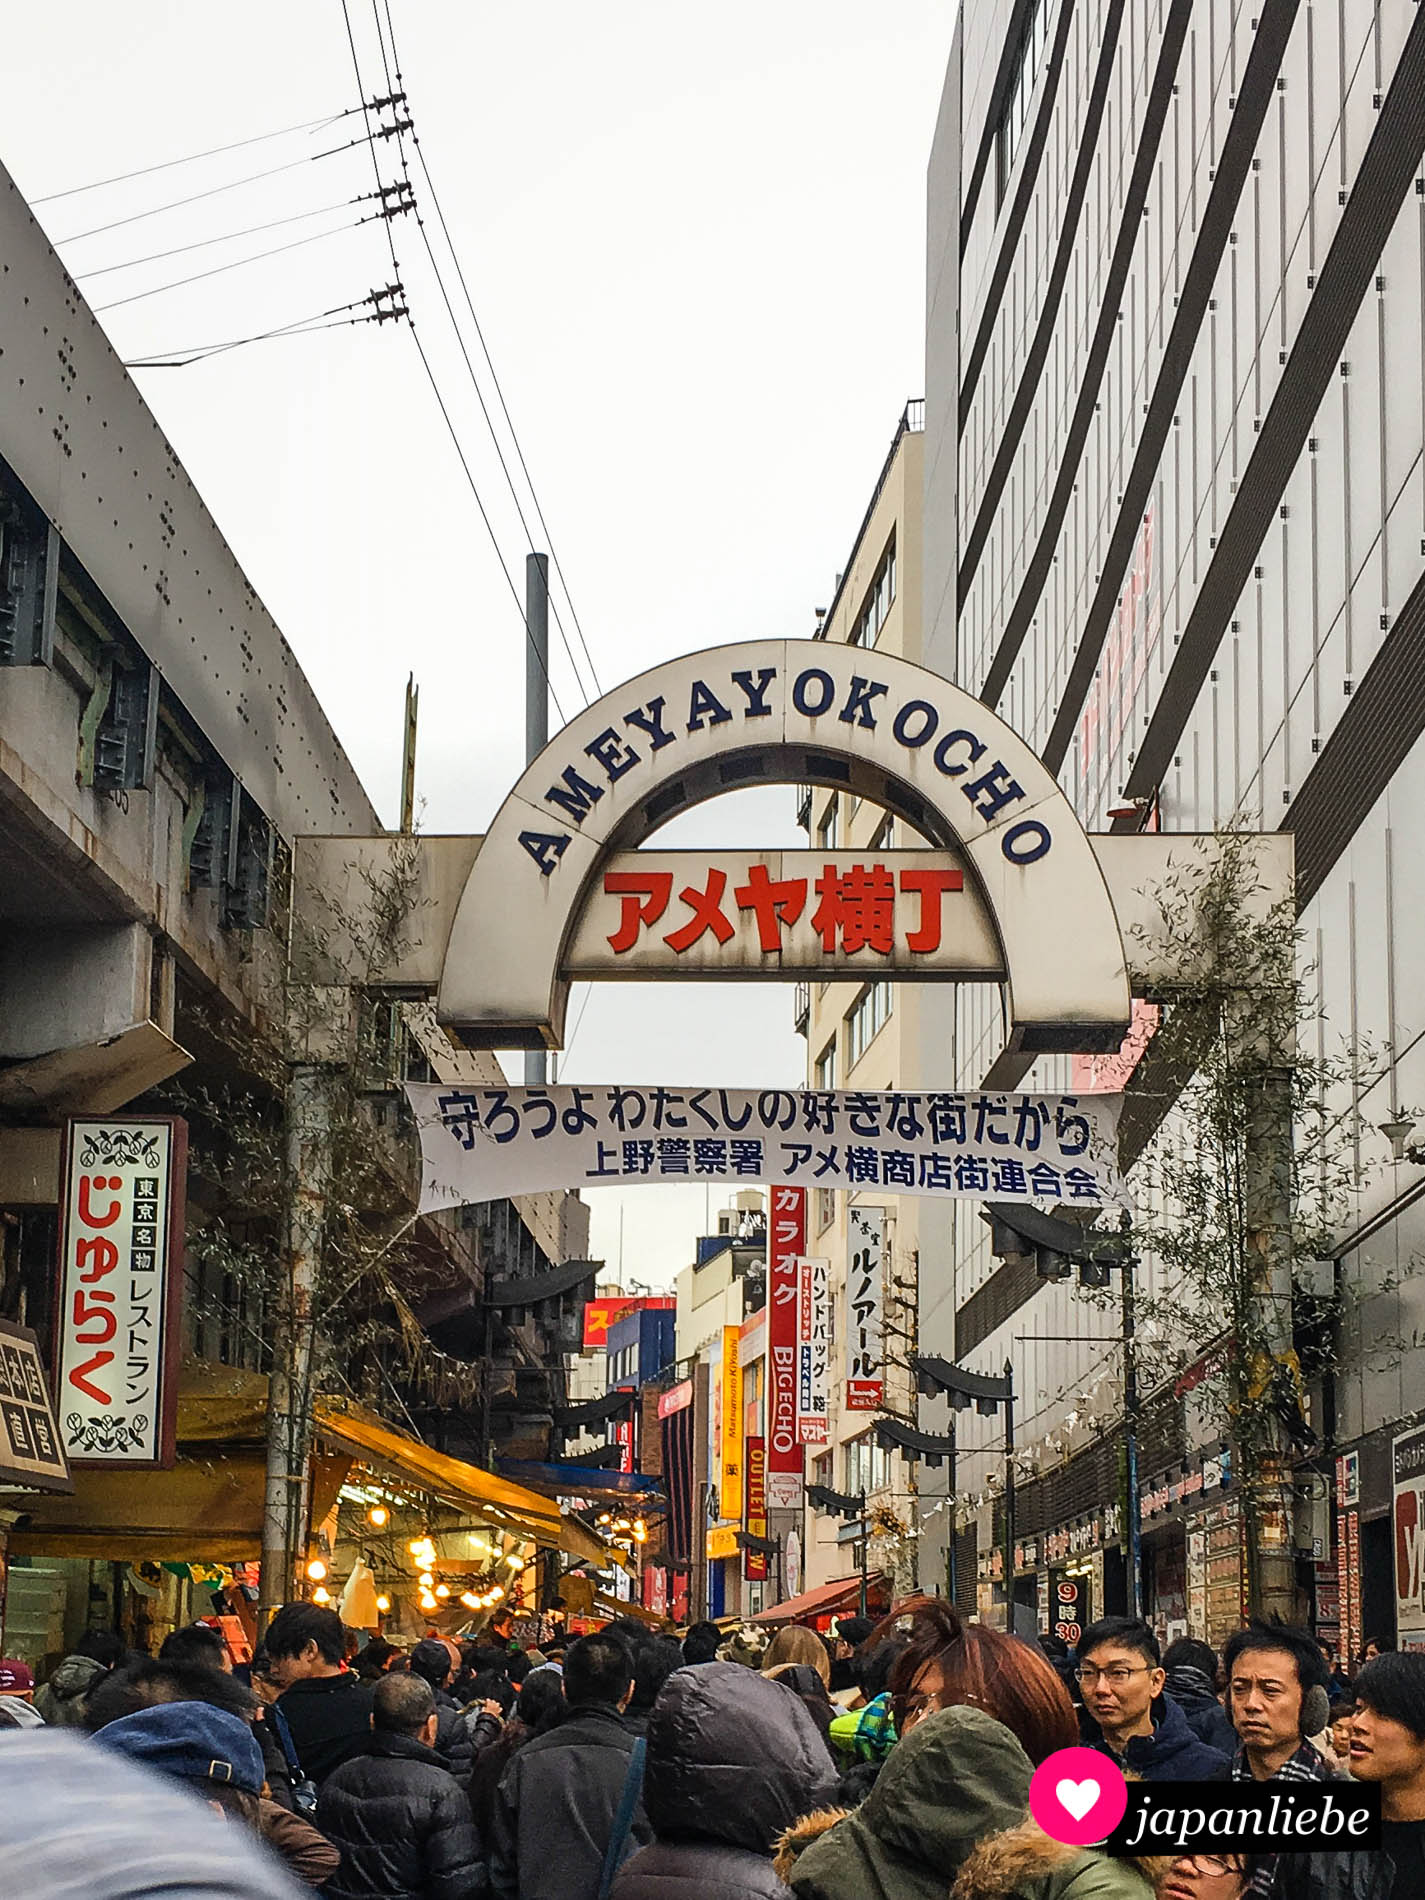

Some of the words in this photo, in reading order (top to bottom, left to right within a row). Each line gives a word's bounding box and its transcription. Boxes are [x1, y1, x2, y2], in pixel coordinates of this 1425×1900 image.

[517, 666, 1052, 876] AMEYAYOKOCHO
[603, 863, 963, 955] アメヤ横丁
[585, 1137, 764, 1177] 上野警察署
[780, 1142, 1102, 1200] アメ横商店街連合会
[131, 1178, 158, 1271] 東京名物
[774, 1189, 800, 1305] カラオケ
[69, 1174, 123, 1406] じゅらく
[851, 1247, 879, 1378] ルノアール
[126, 1279, 153, 1405] レストラン
[774, 1346, 794, 1388] BIG
[773, 1391, 794, 1454] ECHO
[750, 1449, 764, 1515] OUTLET
